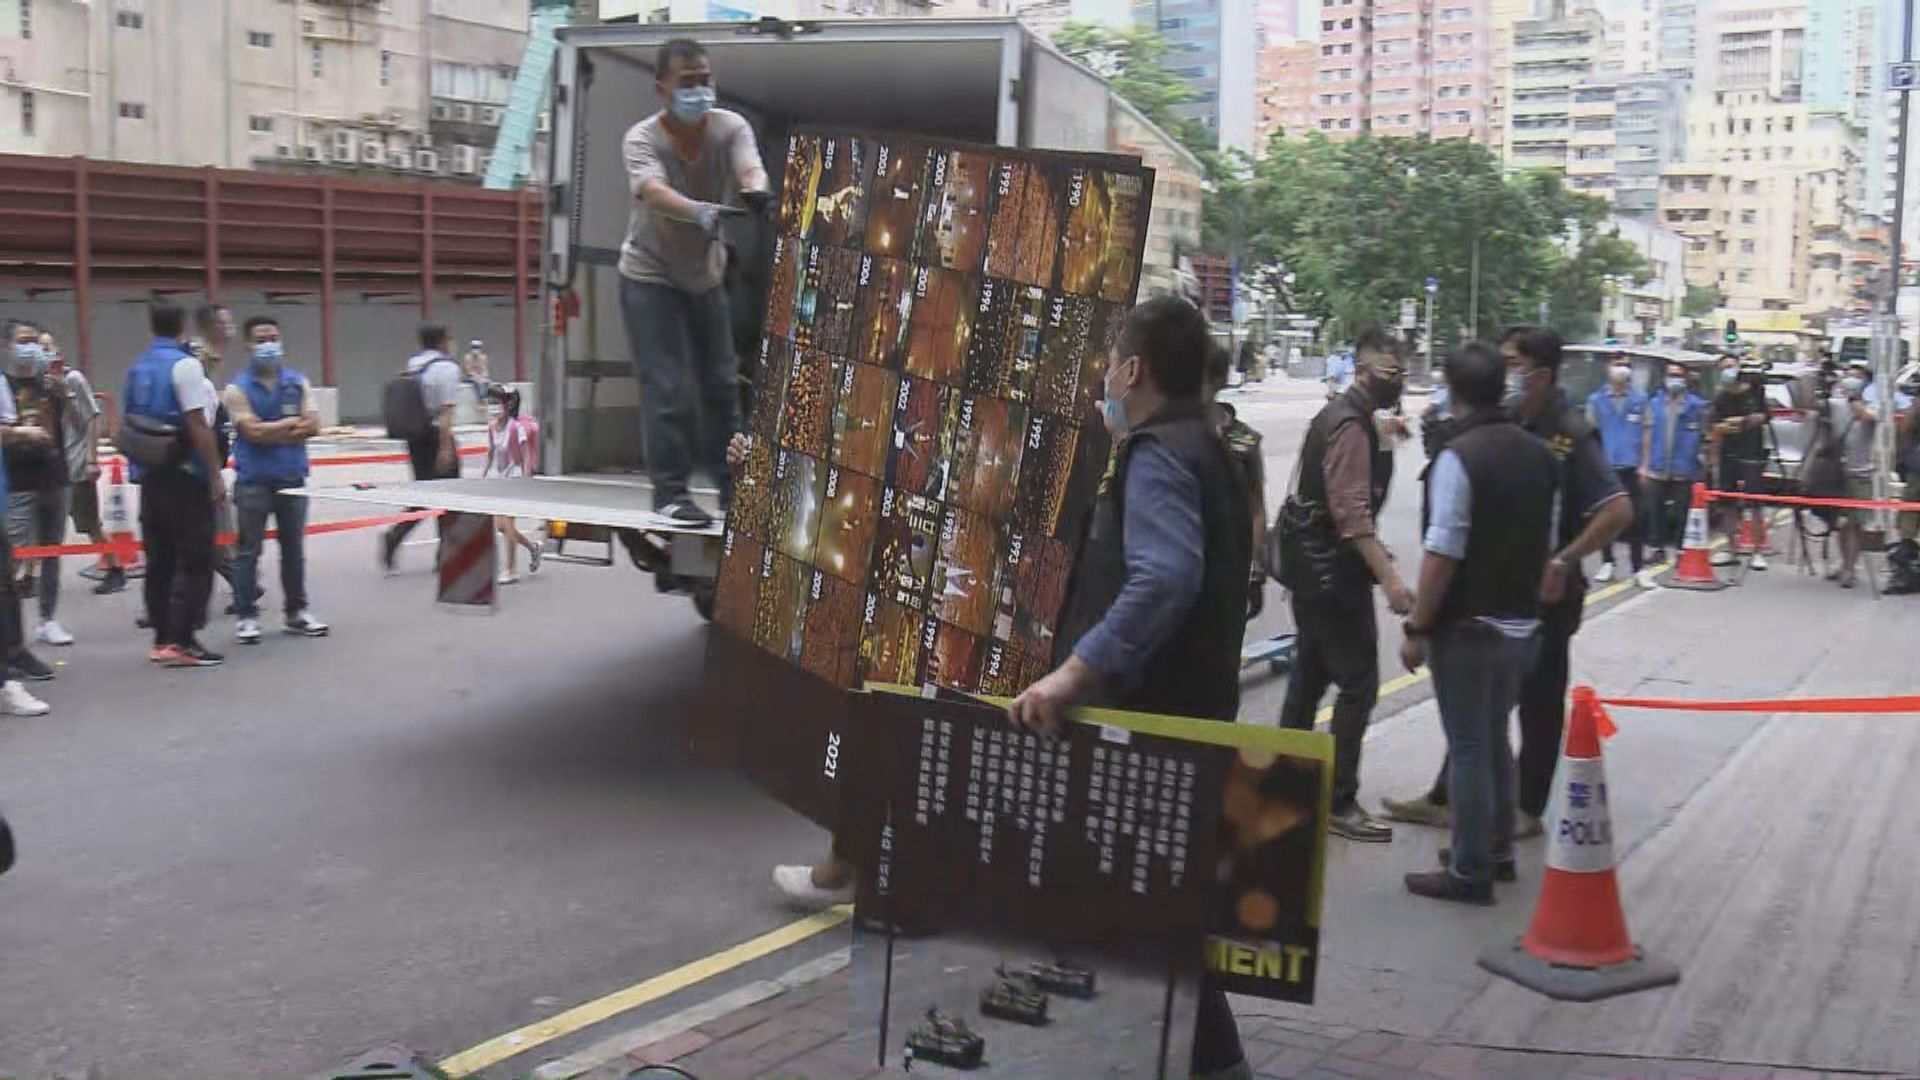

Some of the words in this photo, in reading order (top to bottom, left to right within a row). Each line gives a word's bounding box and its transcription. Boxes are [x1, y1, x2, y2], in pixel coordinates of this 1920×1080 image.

[877, 146, 889, 177] 2005
[934, 154, 947, 185] 2000
[999, 163, 1012, 195] 1995
[1069, 174, 1083, 207] 1990
[860, 256, 872, 286] 2006
[916, 267, 928, 297] 2001
[980, 283, 993, 312] 1996
[1050, 297, 1064, 328] 1991
[844, 364, 855, 393] 2007
[898, 380, 911, 410] 2002
[961, 400, 974, 429] 1997
[1029, 418, 1044, 449] 1992
[827, 469, 839, 498] 2008
[881, 487, 895, 518] 2003
[943, 511, 955, 539] 1998
[1008, 534, 1023, 564] 1993
[812, 571, 823, 600] 2009
[865, 594, 877, 623] 2004
[924, 621, 937, 649] 1999
[989, 647, 1002, 678] 1994
[824, 731, 841, 779] 2021
